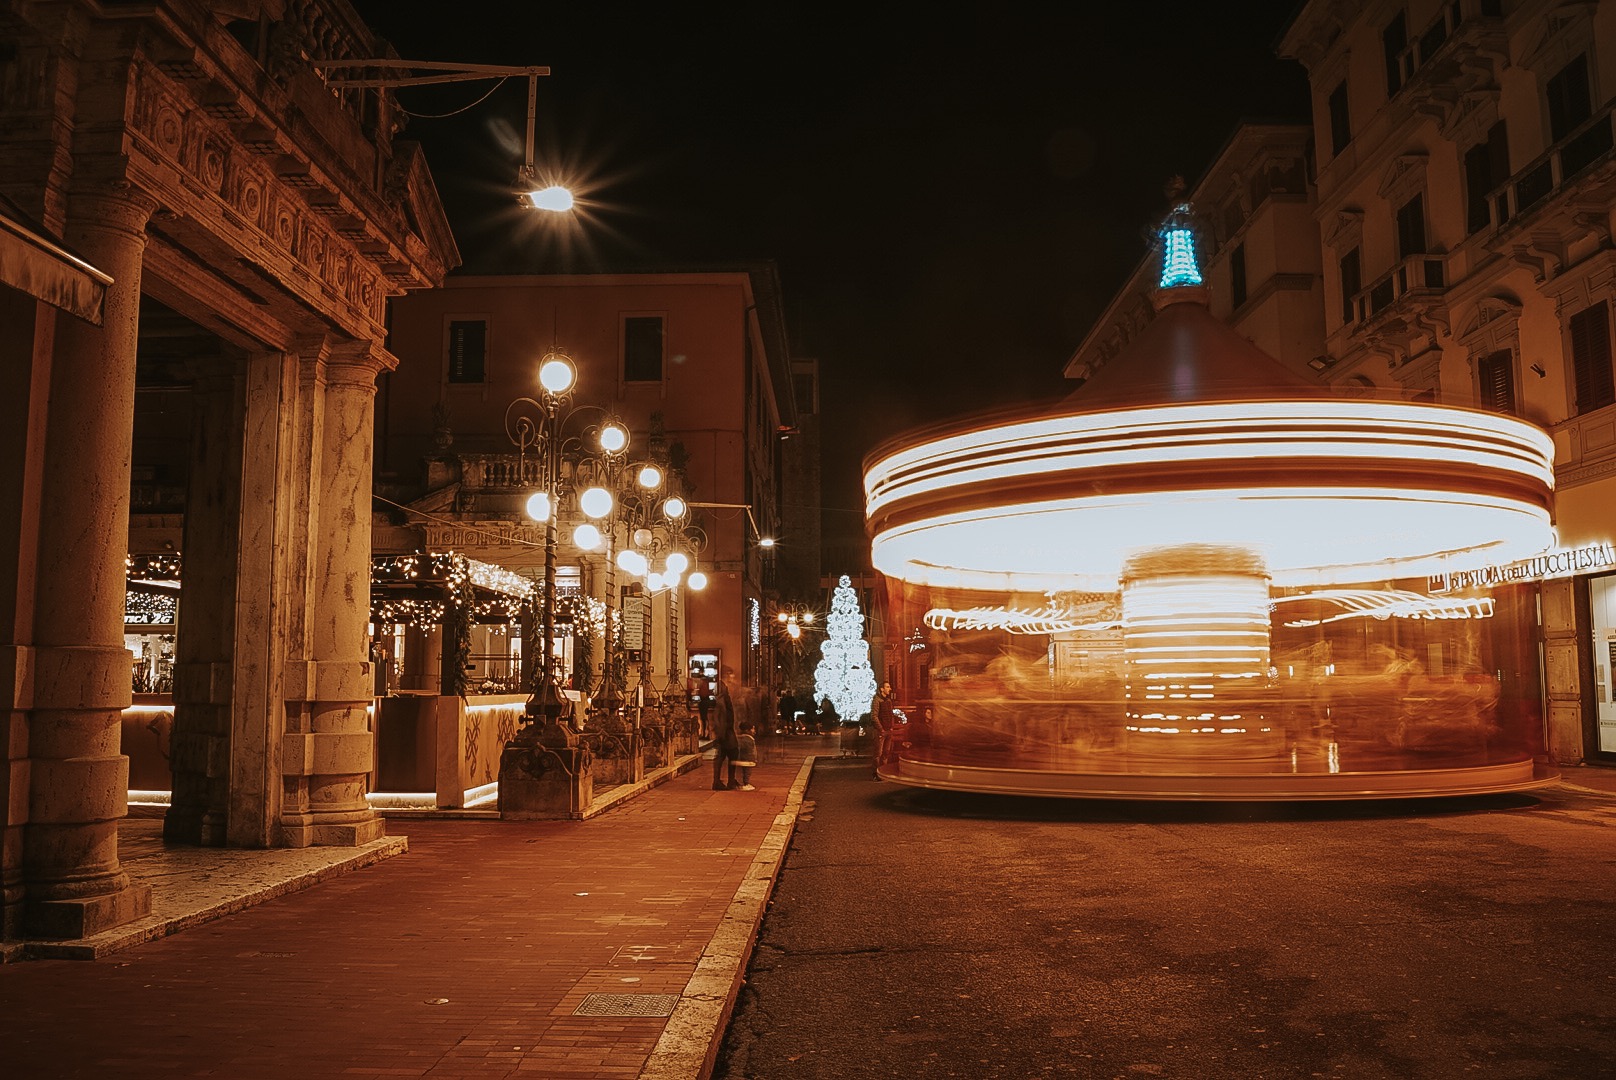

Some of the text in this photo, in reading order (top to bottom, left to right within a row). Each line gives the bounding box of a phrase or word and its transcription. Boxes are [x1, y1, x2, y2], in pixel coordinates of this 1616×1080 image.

[1460, 567, 1500, 588] PISTOIA
[1507, 566, 1532, 581] DELLA
[1532, 545, 1608, 577] LUCCHESIA
